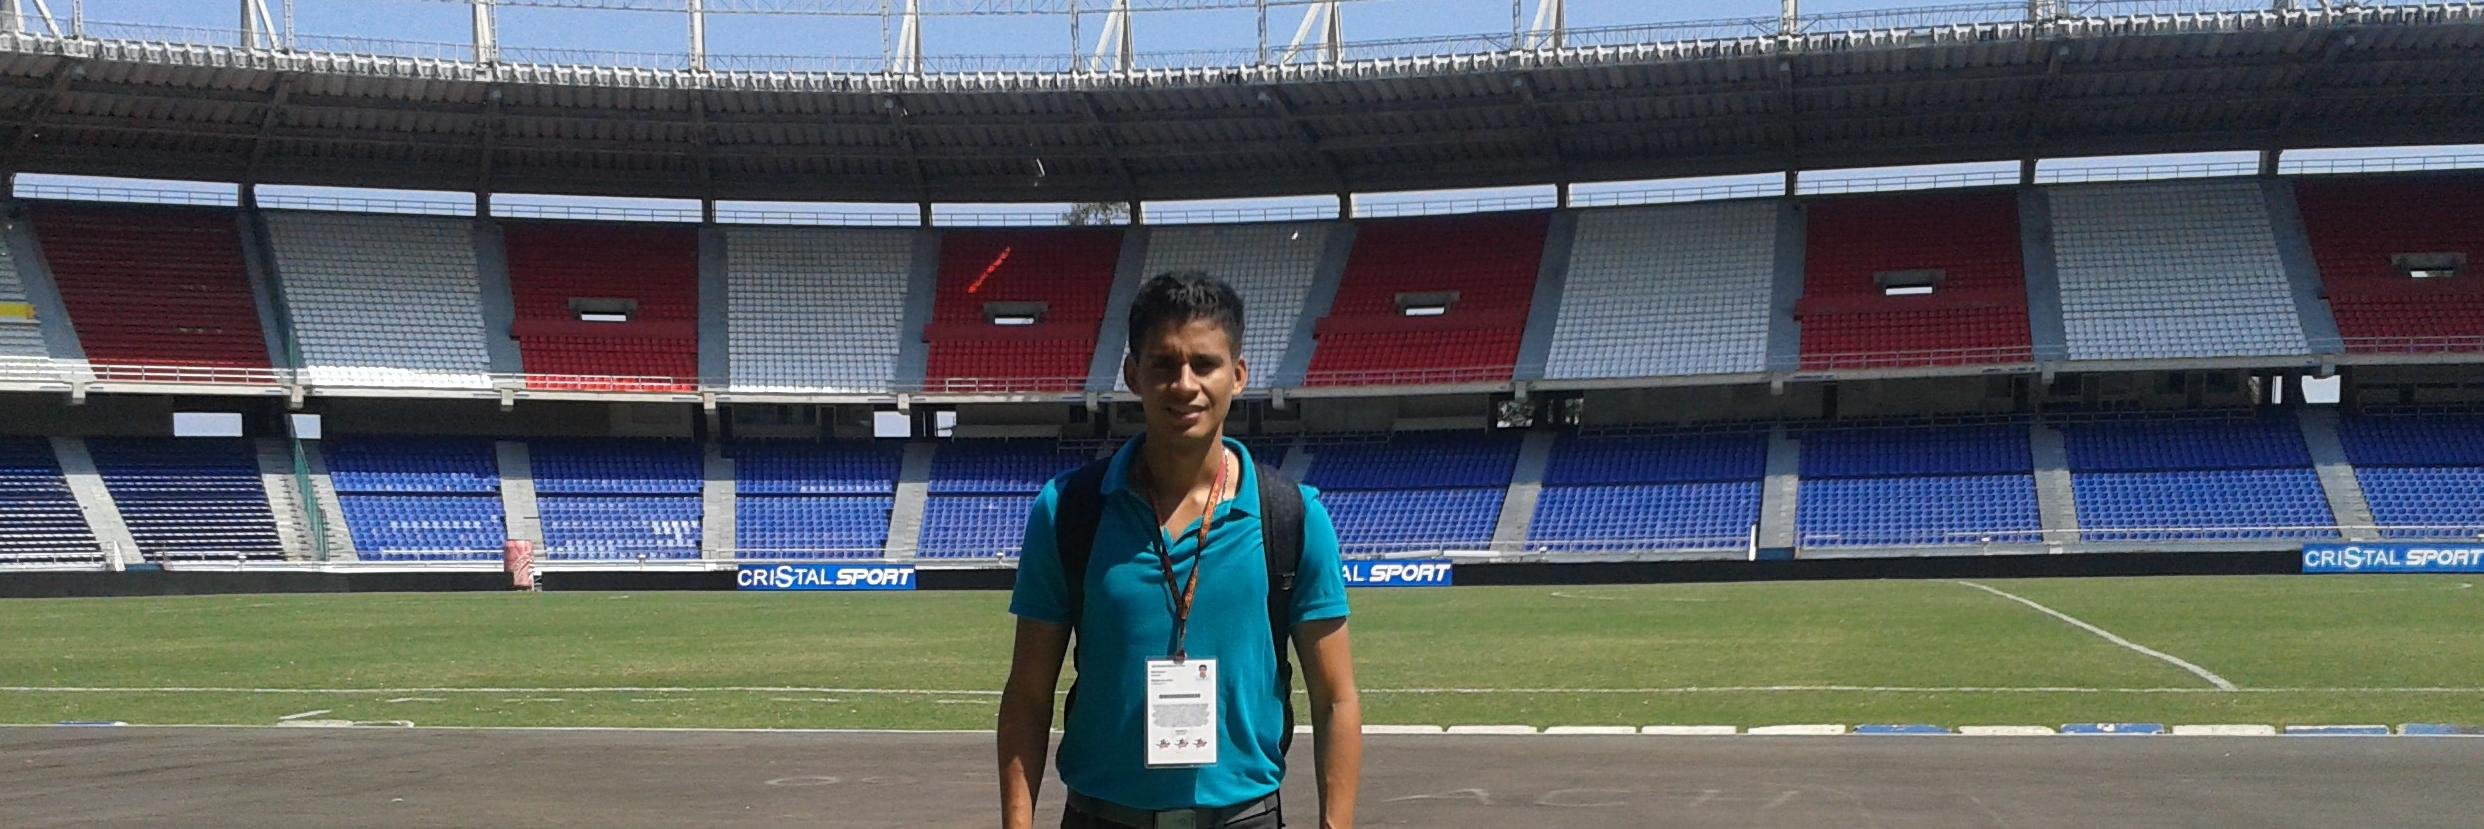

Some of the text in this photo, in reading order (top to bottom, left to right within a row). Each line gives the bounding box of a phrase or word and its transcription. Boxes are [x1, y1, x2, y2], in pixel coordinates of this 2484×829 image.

[2304, 546, 2484, 568] CRISTAL SPORT
[737, 565, 914, 588] CRISTAL SPORT
[1369, 564, 1451, 583] SPORT
